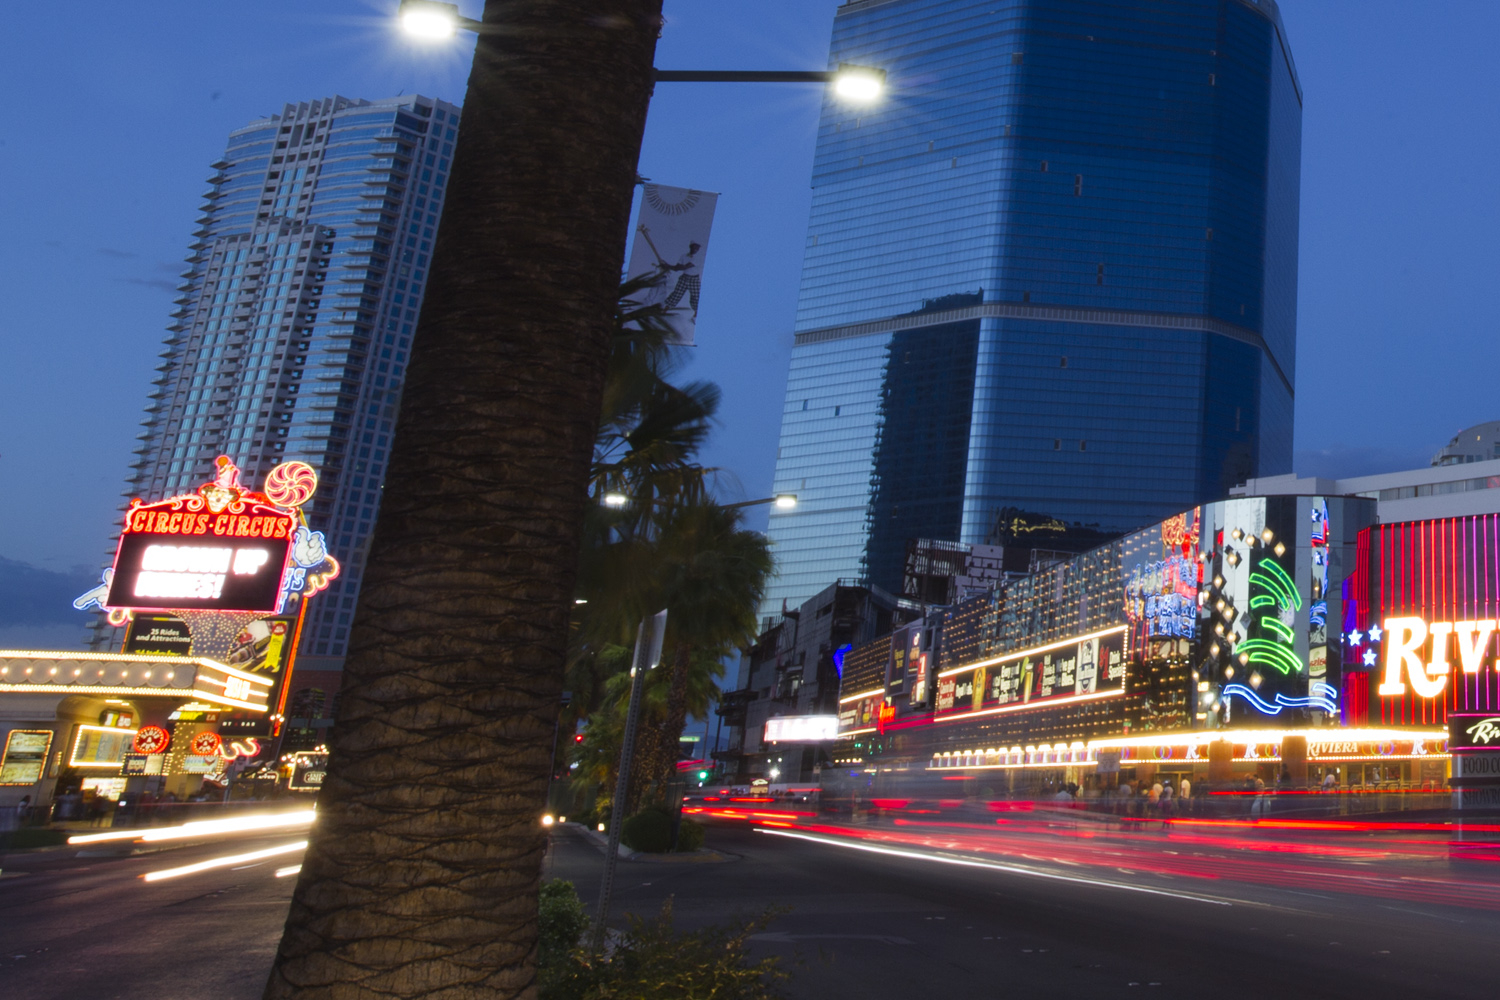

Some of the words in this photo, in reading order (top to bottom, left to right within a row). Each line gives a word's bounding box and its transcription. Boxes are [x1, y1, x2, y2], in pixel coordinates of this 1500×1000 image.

[132, 511, 209, 535] CIRCUS
[213, 514, 289, 539] CIRCUS
[150, 635, 191, 643] Attractions
[160, 628, 179, 636] Rides
[1306, 741, 1358, 757] RIVIERA
[1462, 757, 1490, 774] FOOD
